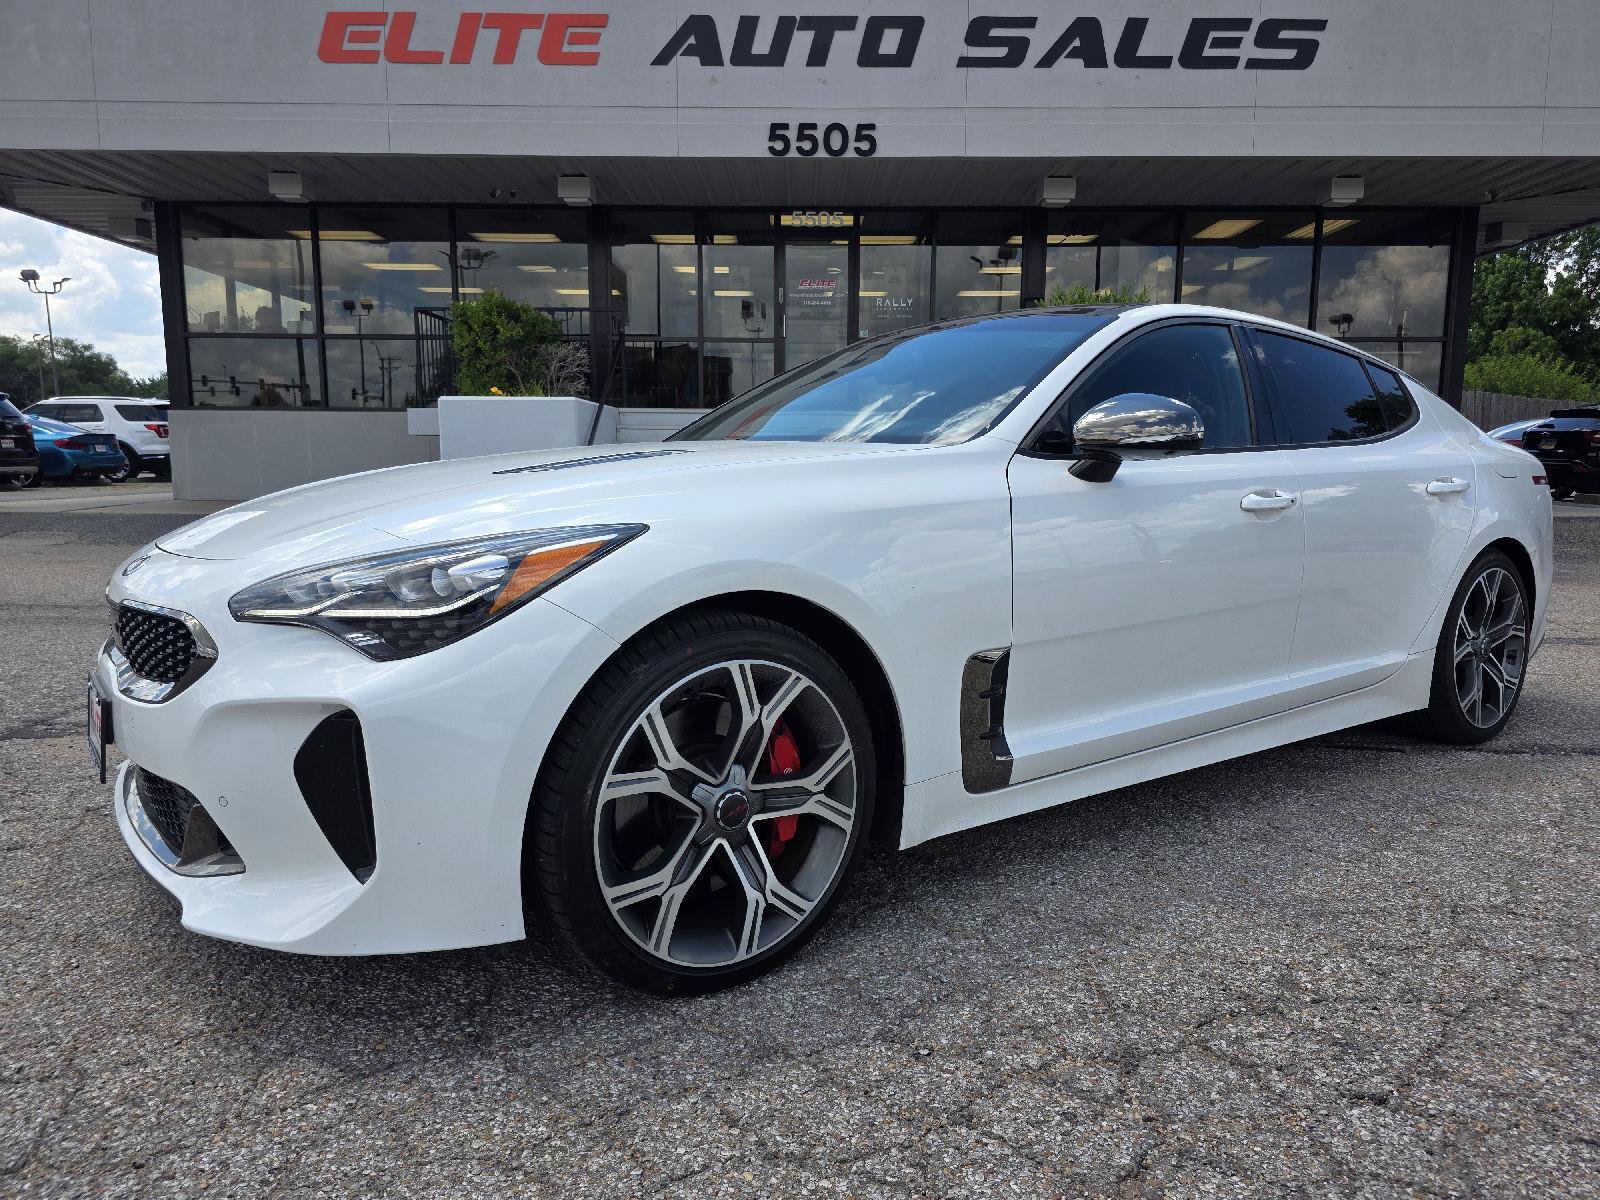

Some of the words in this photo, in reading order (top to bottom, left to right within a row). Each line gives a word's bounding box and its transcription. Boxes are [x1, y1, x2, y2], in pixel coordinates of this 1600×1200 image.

[318, 12, 608, 65] ELITE
[651, 14, 926, 68] AUTO
[957, 16, 1328, 70] SALES
[768, 123, 878, 157] 5505
[791, 211, 843, 227] 5505
[877, 298, 913, 307] RALLY
